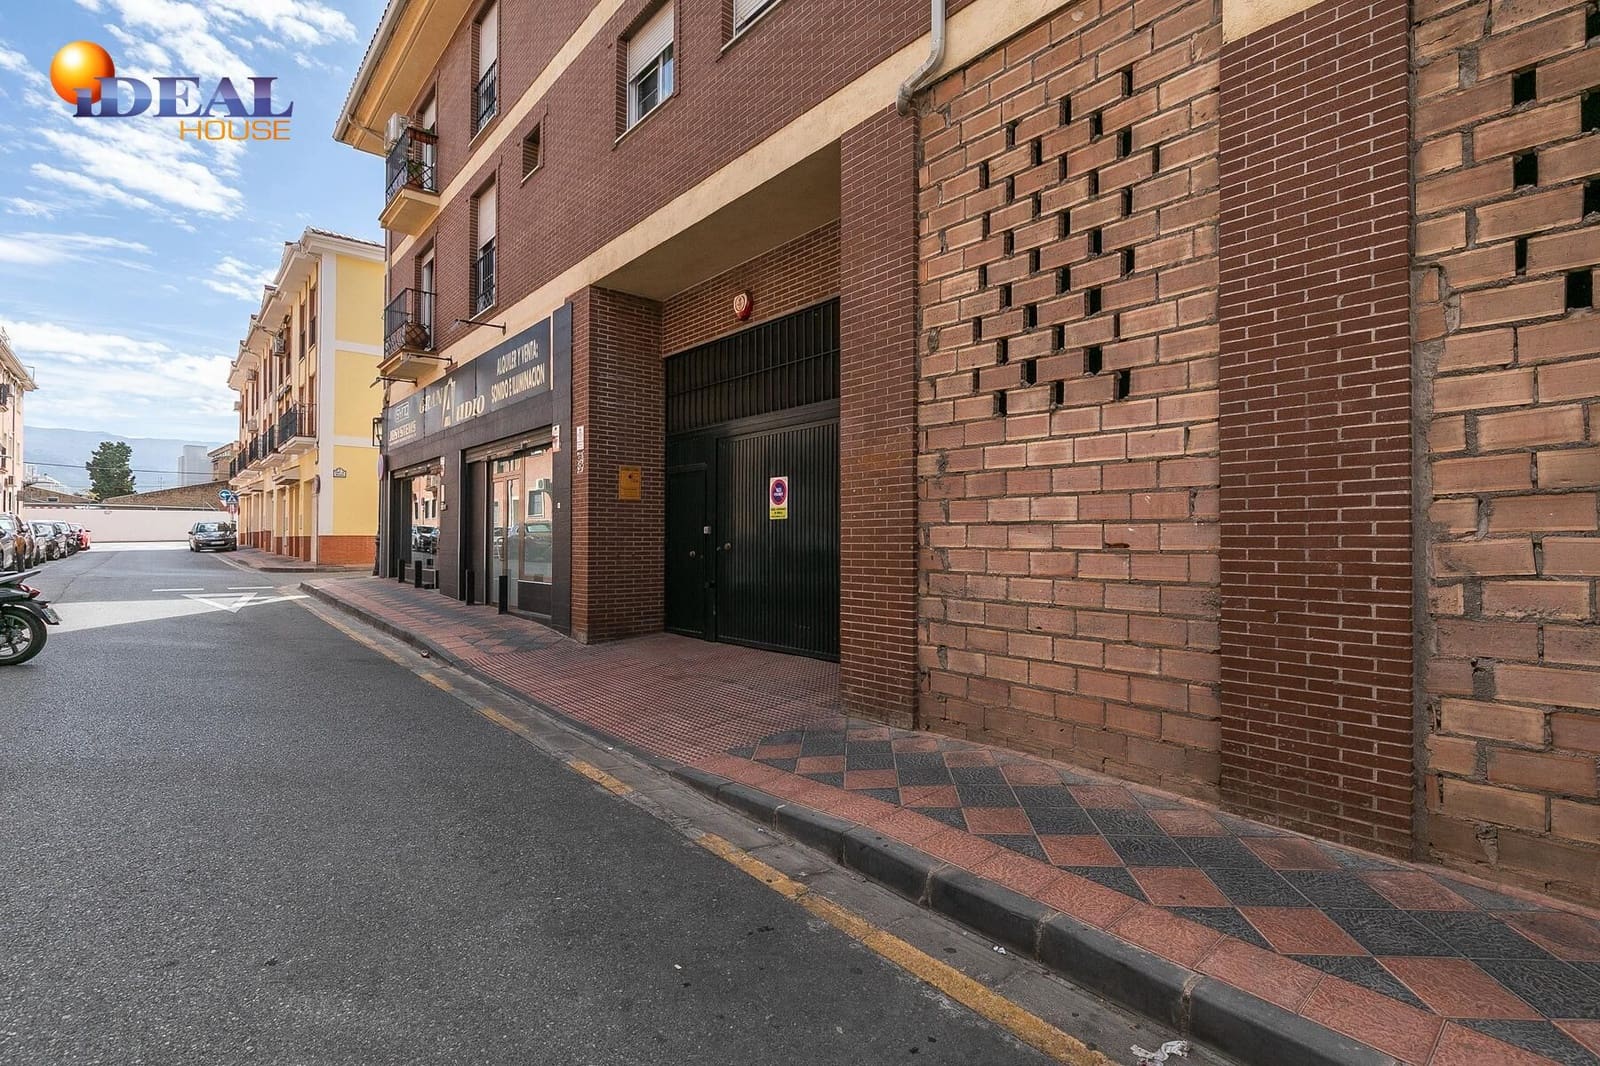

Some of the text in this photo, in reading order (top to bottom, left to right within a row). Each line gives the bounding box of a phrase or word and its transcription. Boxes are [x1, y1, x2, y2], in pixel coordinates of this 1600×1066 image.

[497, 348, 517, 376] ALQUILER
[419, 387, 443, 414] GRAN
[442, 377, 485, 428] AUDIO
[491, 379, 508, 404] SONIDO
